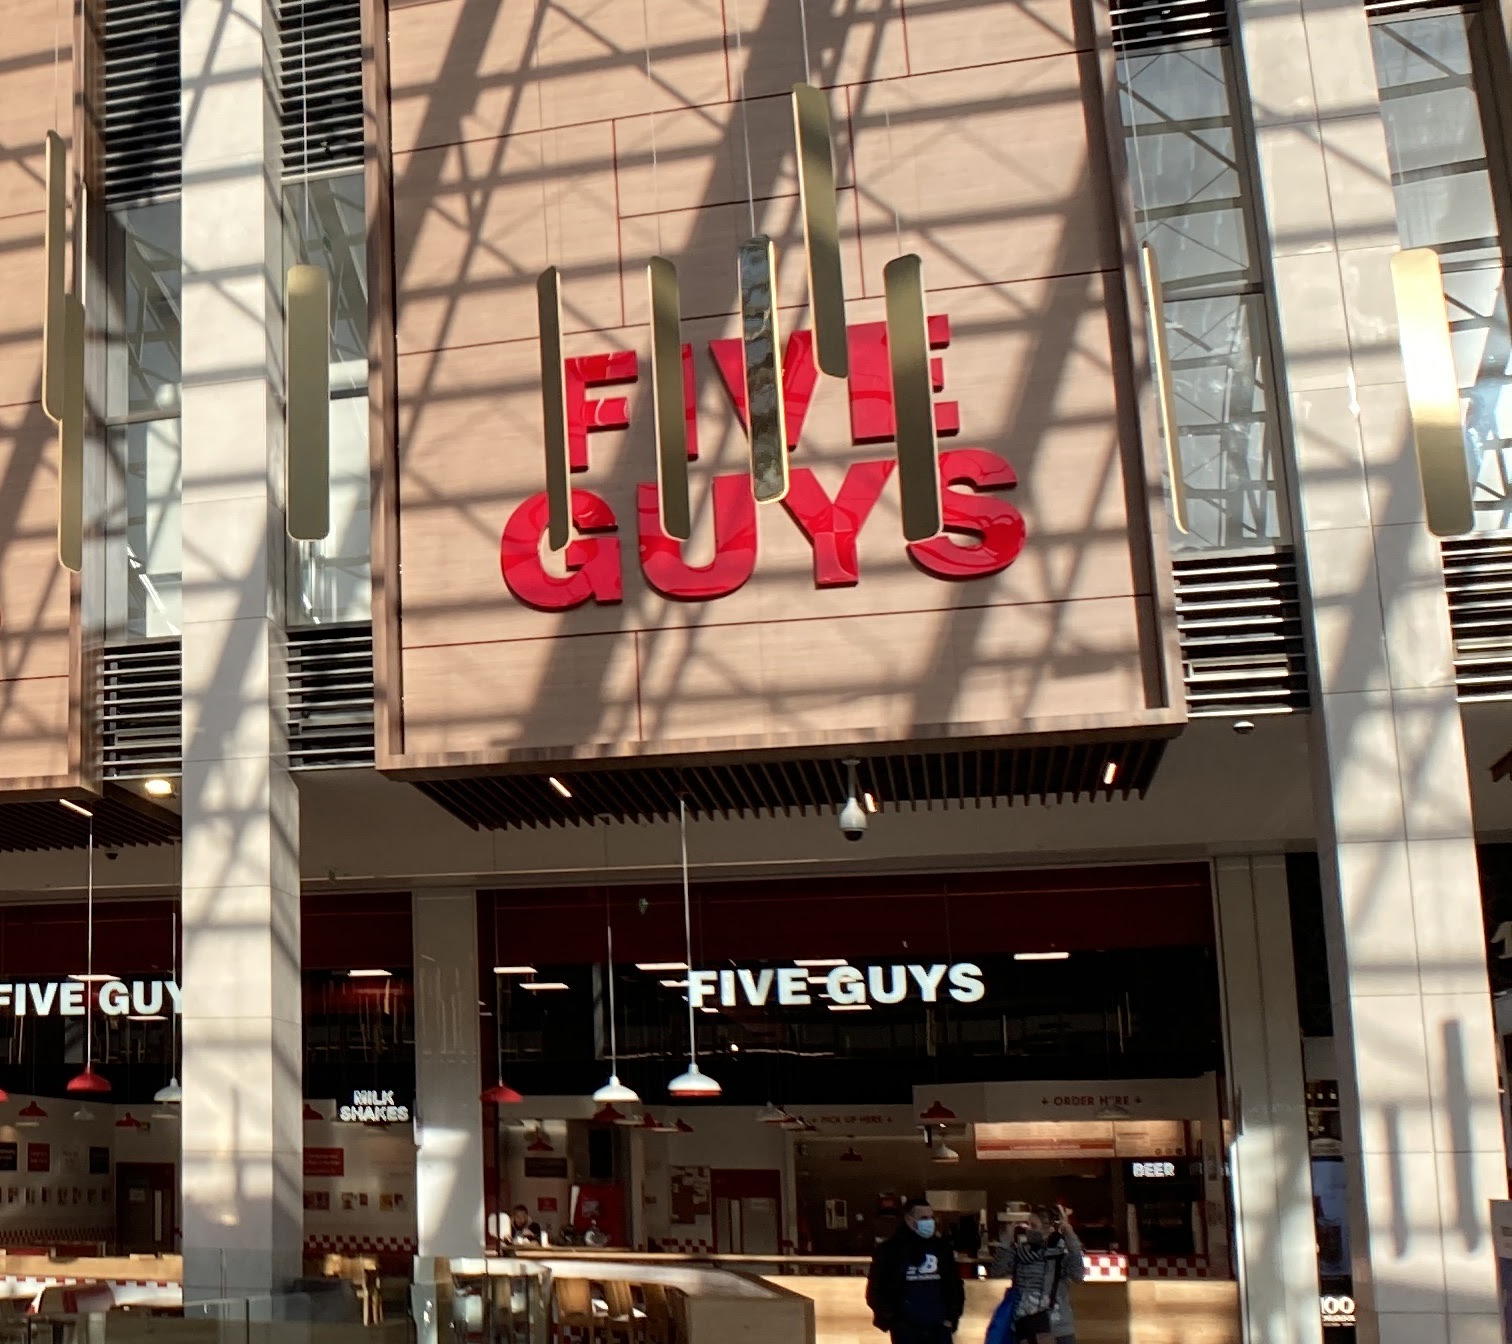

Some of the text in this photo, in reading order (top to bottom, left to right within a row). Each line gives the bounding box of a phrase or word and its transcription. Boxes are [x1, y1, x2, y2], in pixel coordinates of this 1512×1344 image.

[501, 448, 1026, 612] GUYS
[689, 962, 985, 1007] FIVE GUYS
[98, 980, 183, 1016] GUY
[353, 1090, 395, 1105] MILK
[340, 1105, 410, 1122] SHAKES
[1132, 1161, 1176, 1178] BEER
